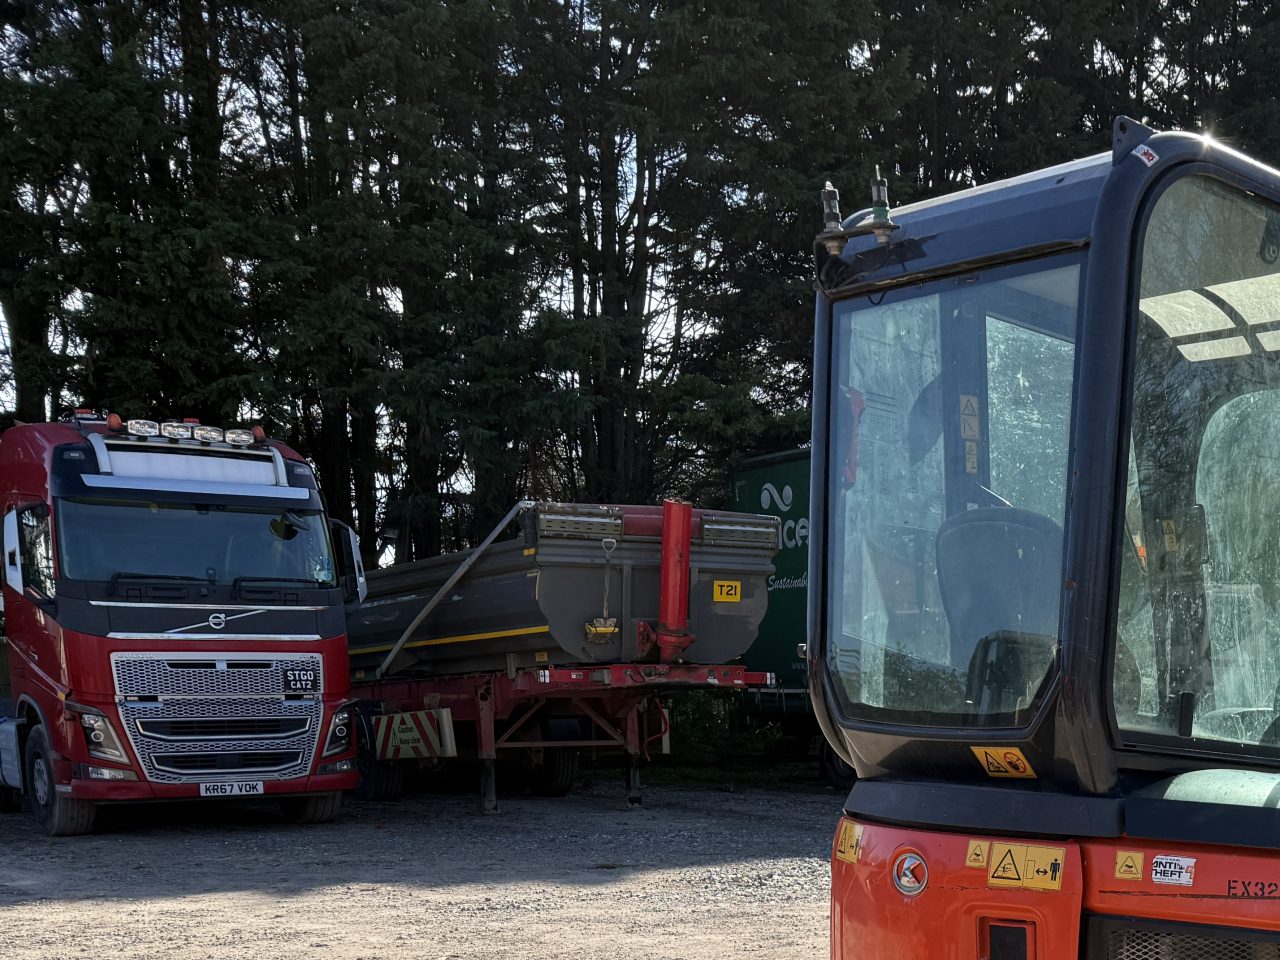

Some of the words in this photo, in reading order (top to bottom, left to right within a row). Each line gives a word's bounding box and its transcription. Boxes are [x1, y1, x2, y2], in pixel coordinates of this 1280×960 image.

[718, 584, 737, 596] T21
[287, 670, 314, 681] STGO
[290, 681, 312, 689] CAT2
[204, 782, 234, 794] KR67
[237, 782, 259, 793] VOK
[1152, 860, 1177, 870] ANTI
